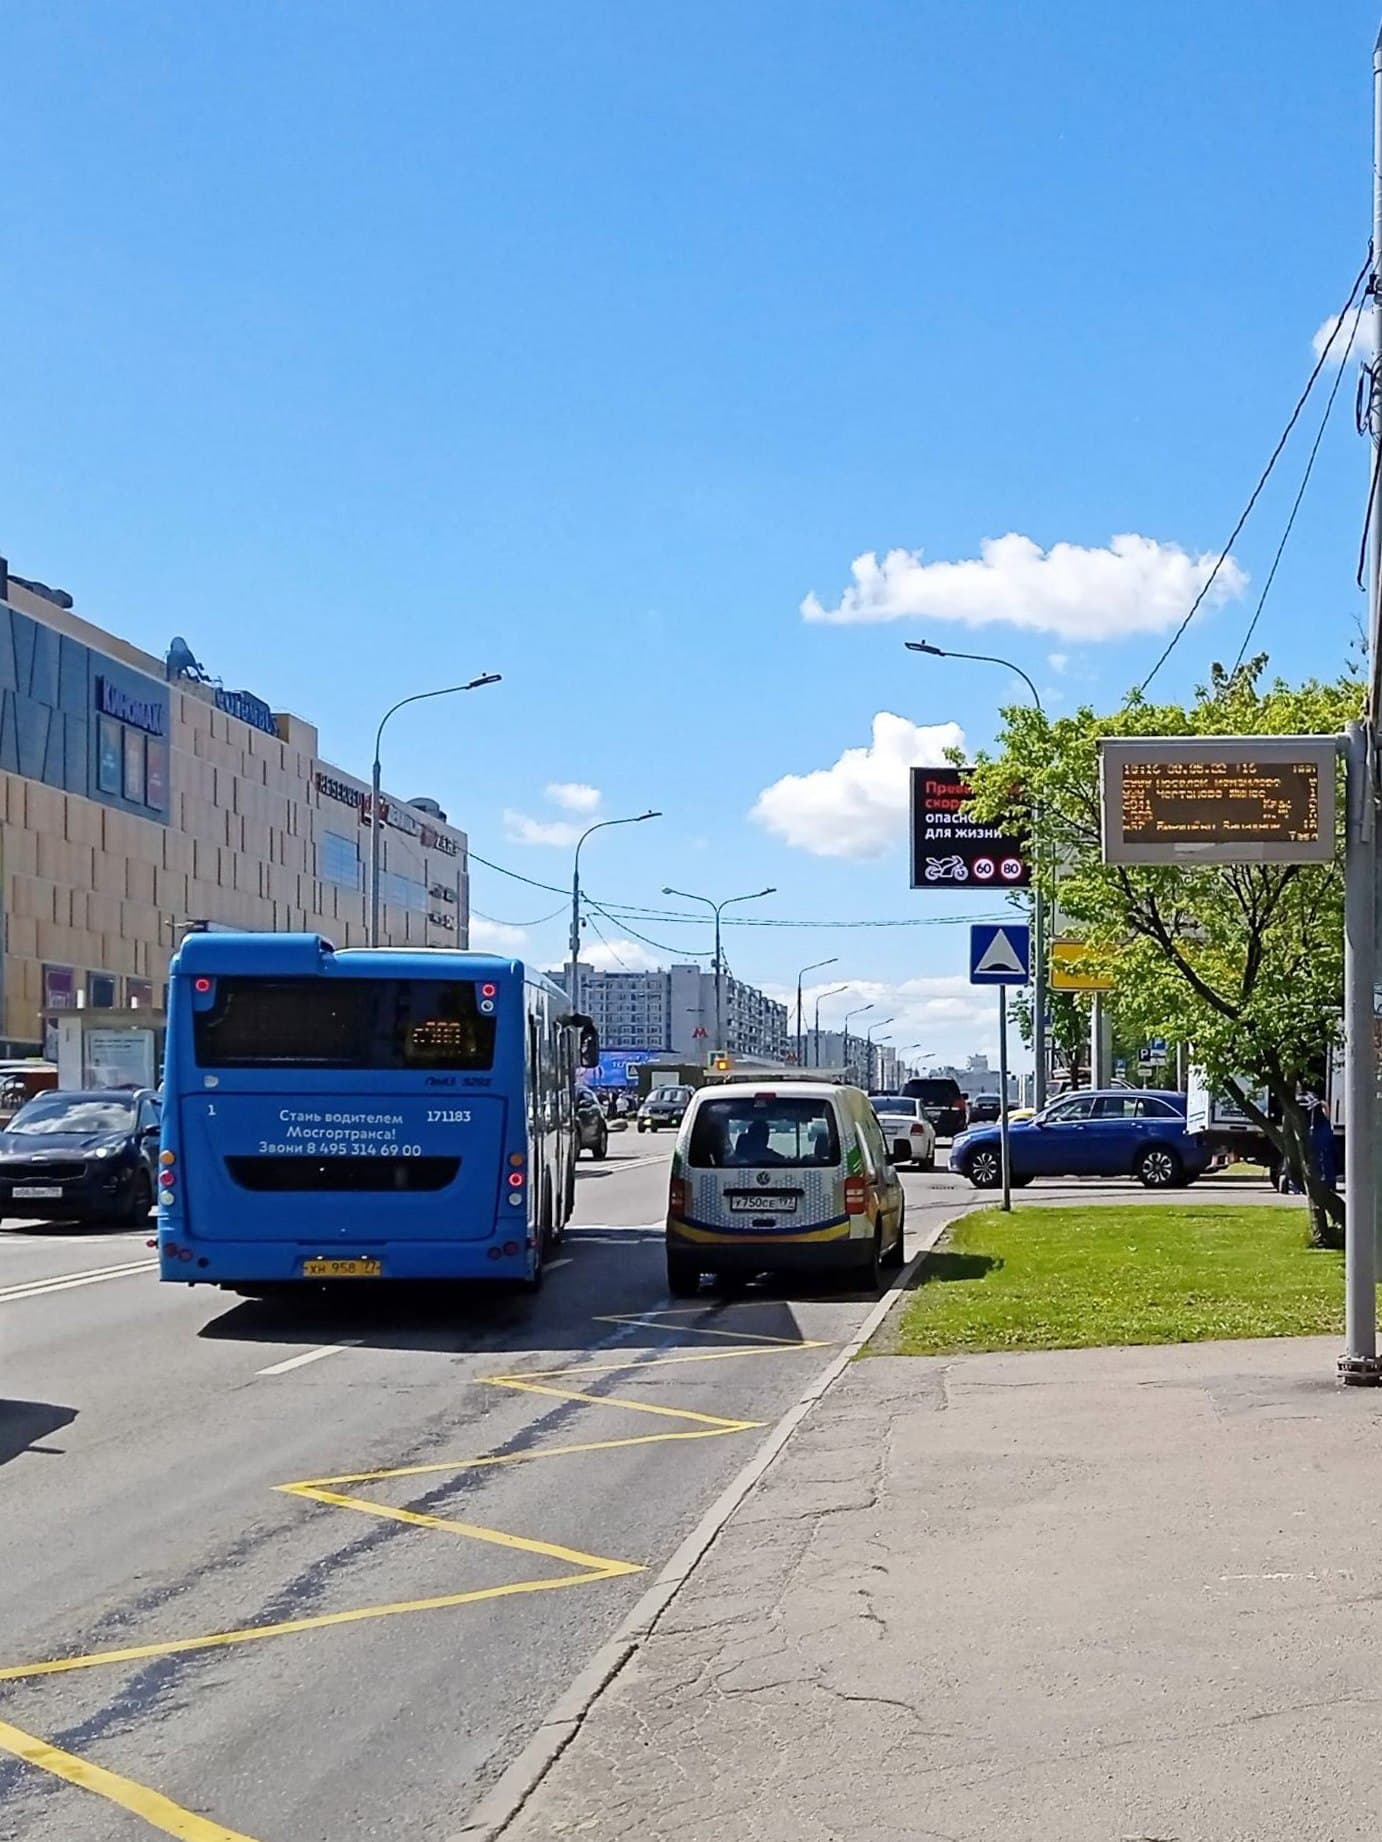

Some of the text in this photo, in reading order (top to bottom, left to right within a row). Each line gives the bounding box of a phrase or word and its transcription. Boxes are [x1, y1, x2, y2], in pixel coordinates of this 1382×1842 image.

[924, 828, 1003, 840] для жизни
[976, 863, 992, 874] 60
[1004, 863, 1019, 874] 80
[1141, 1048, 1149, 1059] P
[208, 1104, 216, 1115] 1
[279, 1109, 404, 1124] Стань водителем
[427, 1110, 472, 1122] 171183
[287, 1126, 396, 1140] Мосгортранса!
[259, 1141, 422, 1156] Звони 8 495 314 69 00
[331, 1262, 356, 1273] 958
